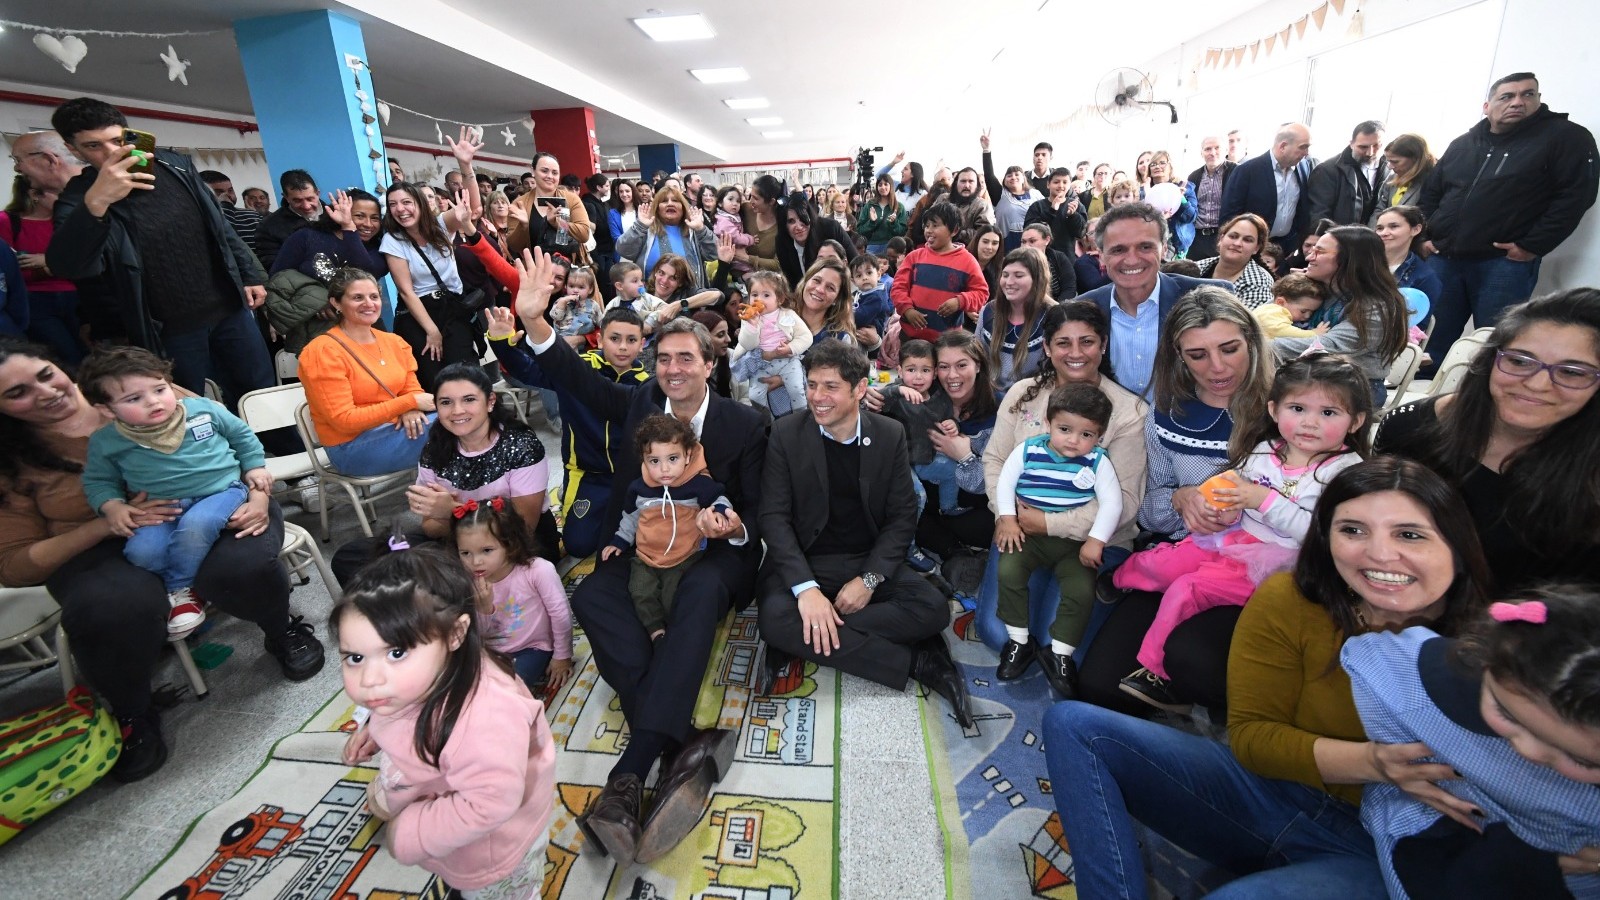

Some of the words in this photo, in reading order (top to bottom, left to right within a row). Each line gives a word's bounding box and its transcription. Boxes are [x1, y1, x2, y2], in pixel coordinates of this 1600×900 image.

[796, 700, 811, 733] Stand
[794, 736, 807, 761] Stall
[336, 813, 369, 846] Fire
[289, 849, 341, 900] house
